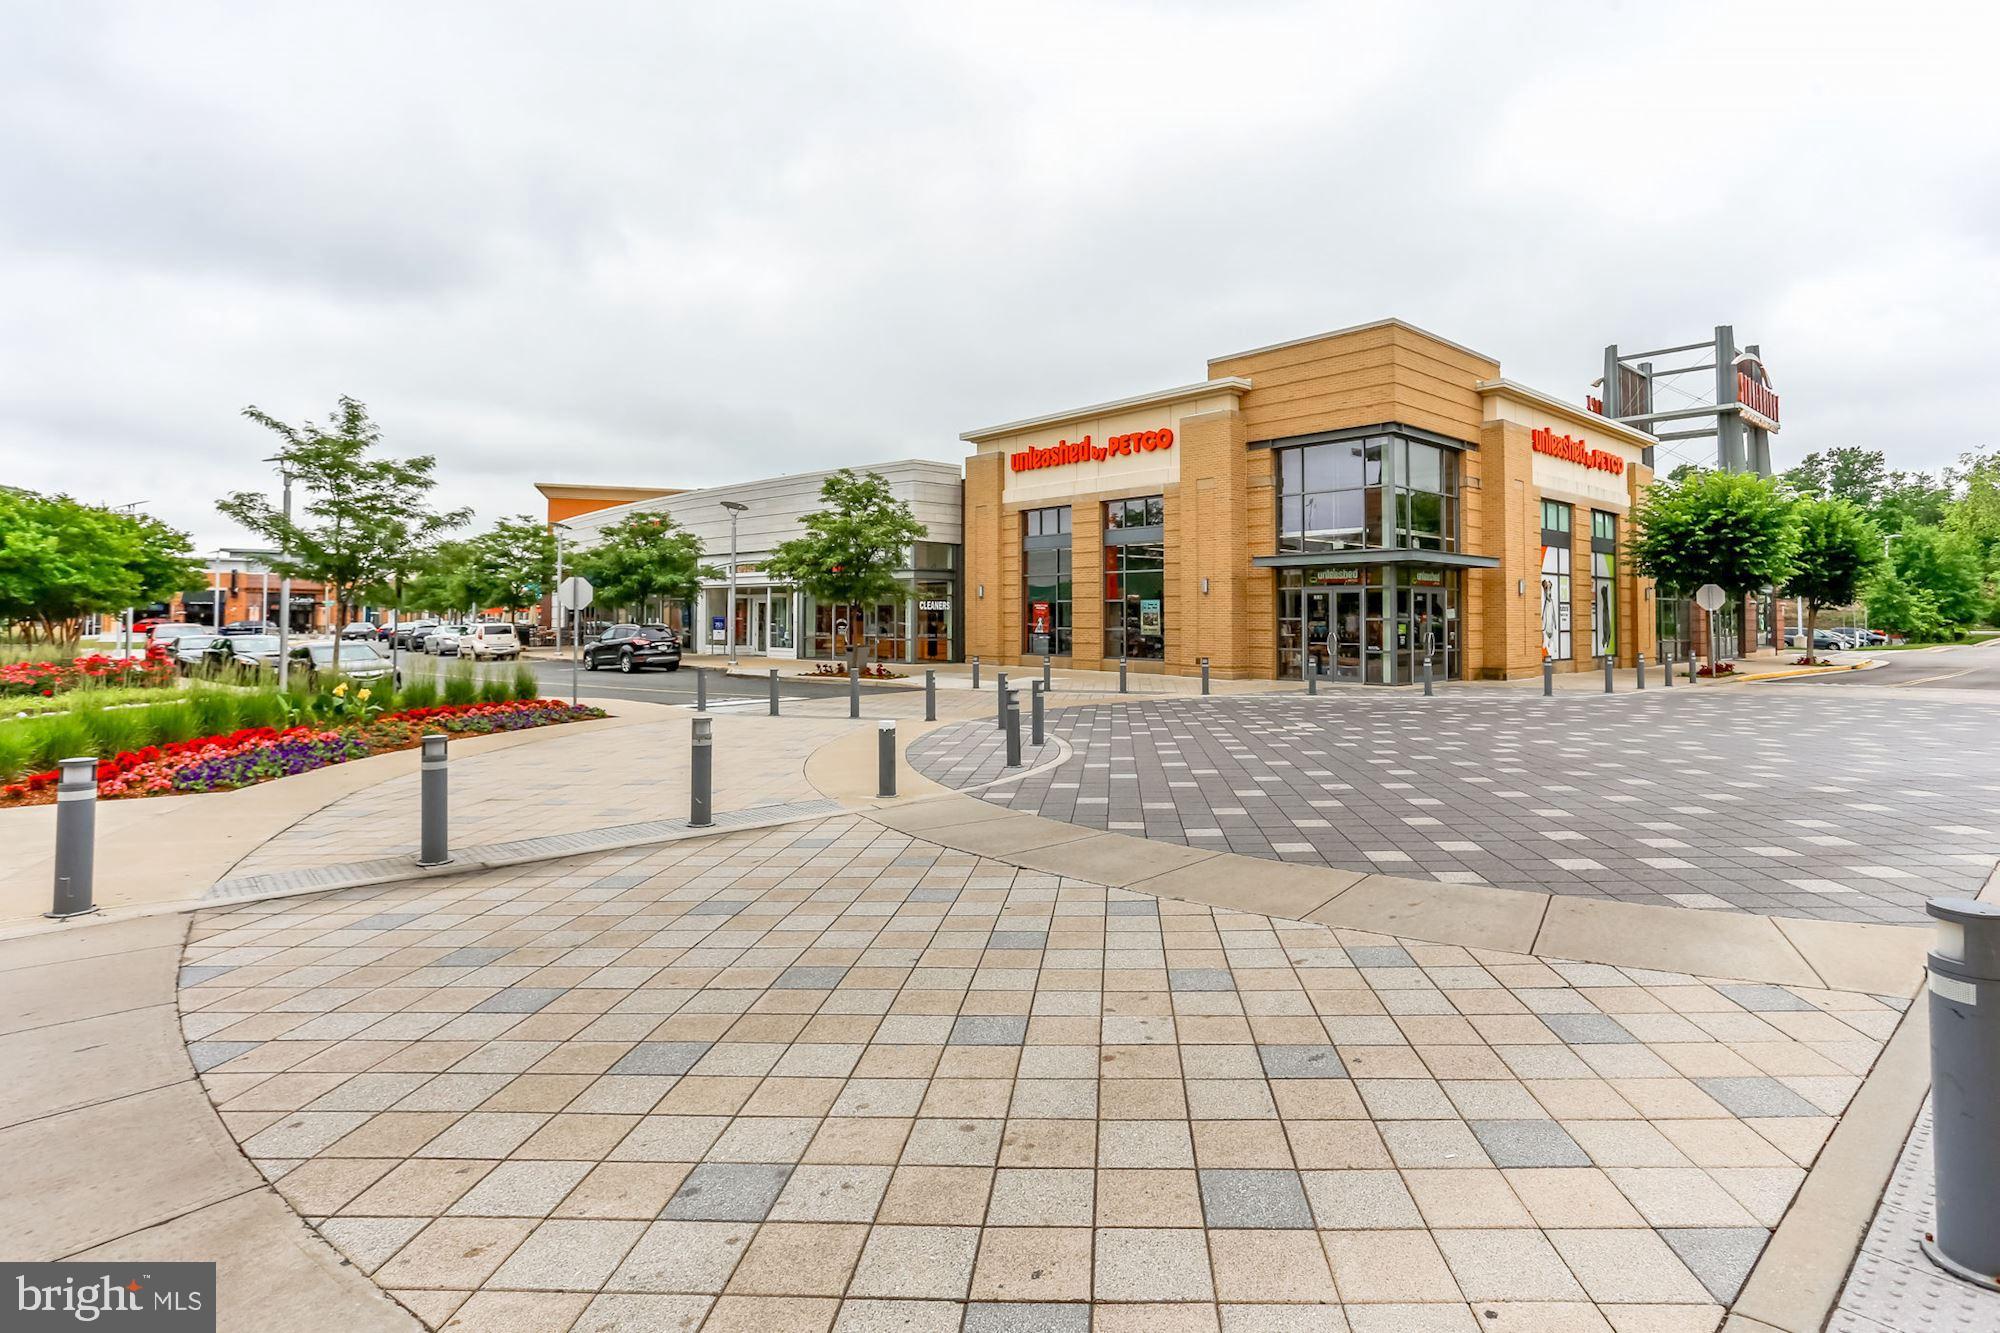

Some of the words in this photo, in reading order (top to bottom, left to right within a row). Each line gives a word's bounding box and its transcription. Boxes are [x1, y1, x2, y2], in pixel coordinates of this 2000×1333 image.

[1011, 435, 1091, 472] unleashed
[1091, 446, 1107, 462] by
[1108, 428, 1174, 457] PETCO
[1532, 427, 1587, 466] unleashed
[1592, 449, 1624, 475] PETCO
[919, 601, 951, 610] CLEANERS
